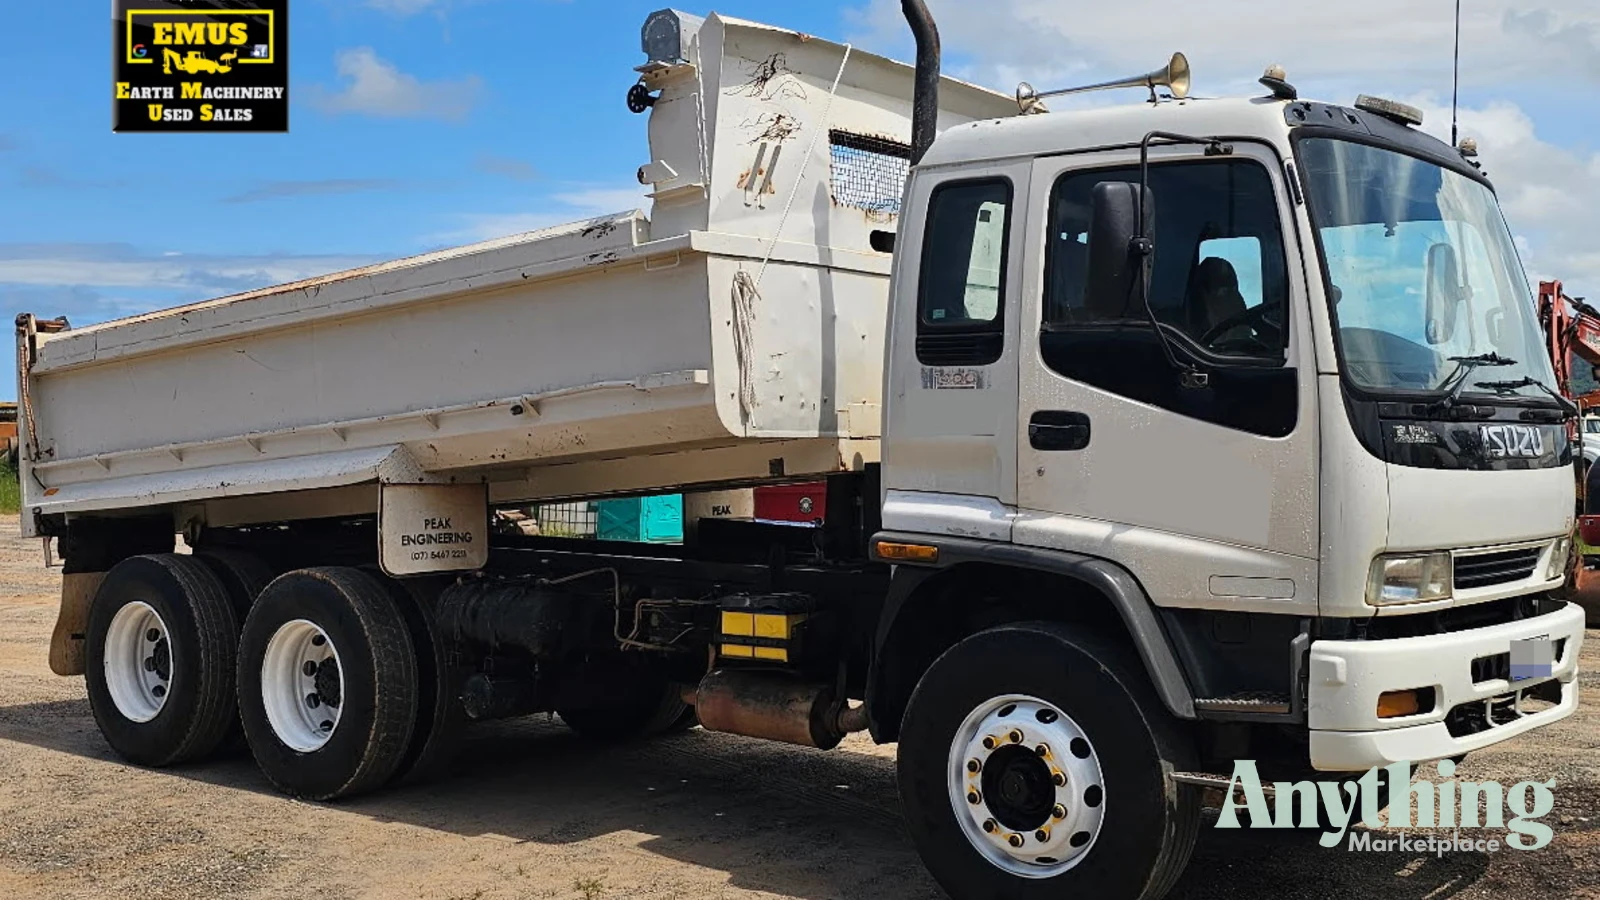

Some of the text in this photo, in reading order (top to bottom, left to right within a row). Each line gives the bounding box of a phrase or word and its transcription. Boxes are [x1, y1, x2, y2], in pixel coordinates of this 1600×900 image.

[1479, 425, 1544, 457] ISUZU
[712, 505, 732, 516] PEAK
[424, 518, 452, 530] PEAK
[401, 532, 473, 546] ENGINEERING
[411, 551, 429, 561] (07)
